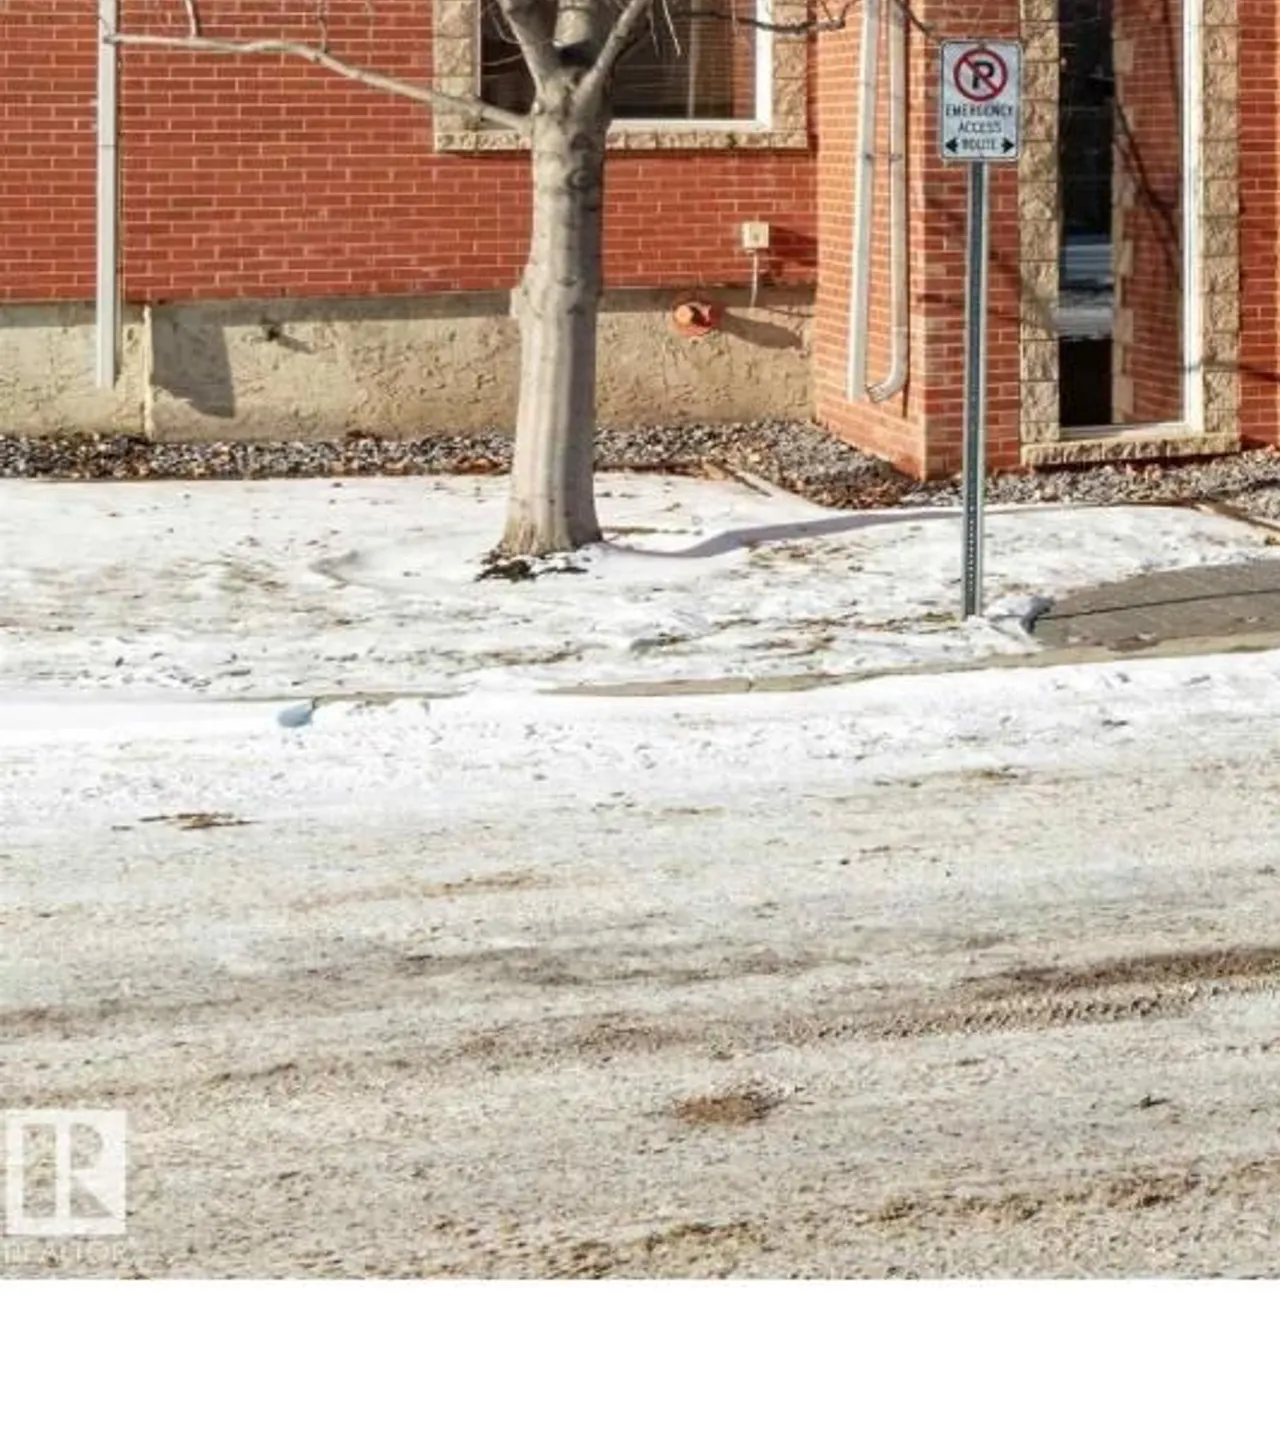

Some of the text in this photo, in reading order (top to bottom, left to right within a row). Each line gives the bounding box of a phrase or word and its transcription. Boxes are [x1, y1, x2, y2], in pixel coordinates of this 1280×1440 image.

[945, 104, 1013, 117] EMERGENCY
[958, 120, 1002, 133] ACCESS
[961, 139, 997, 150] ROUTE
